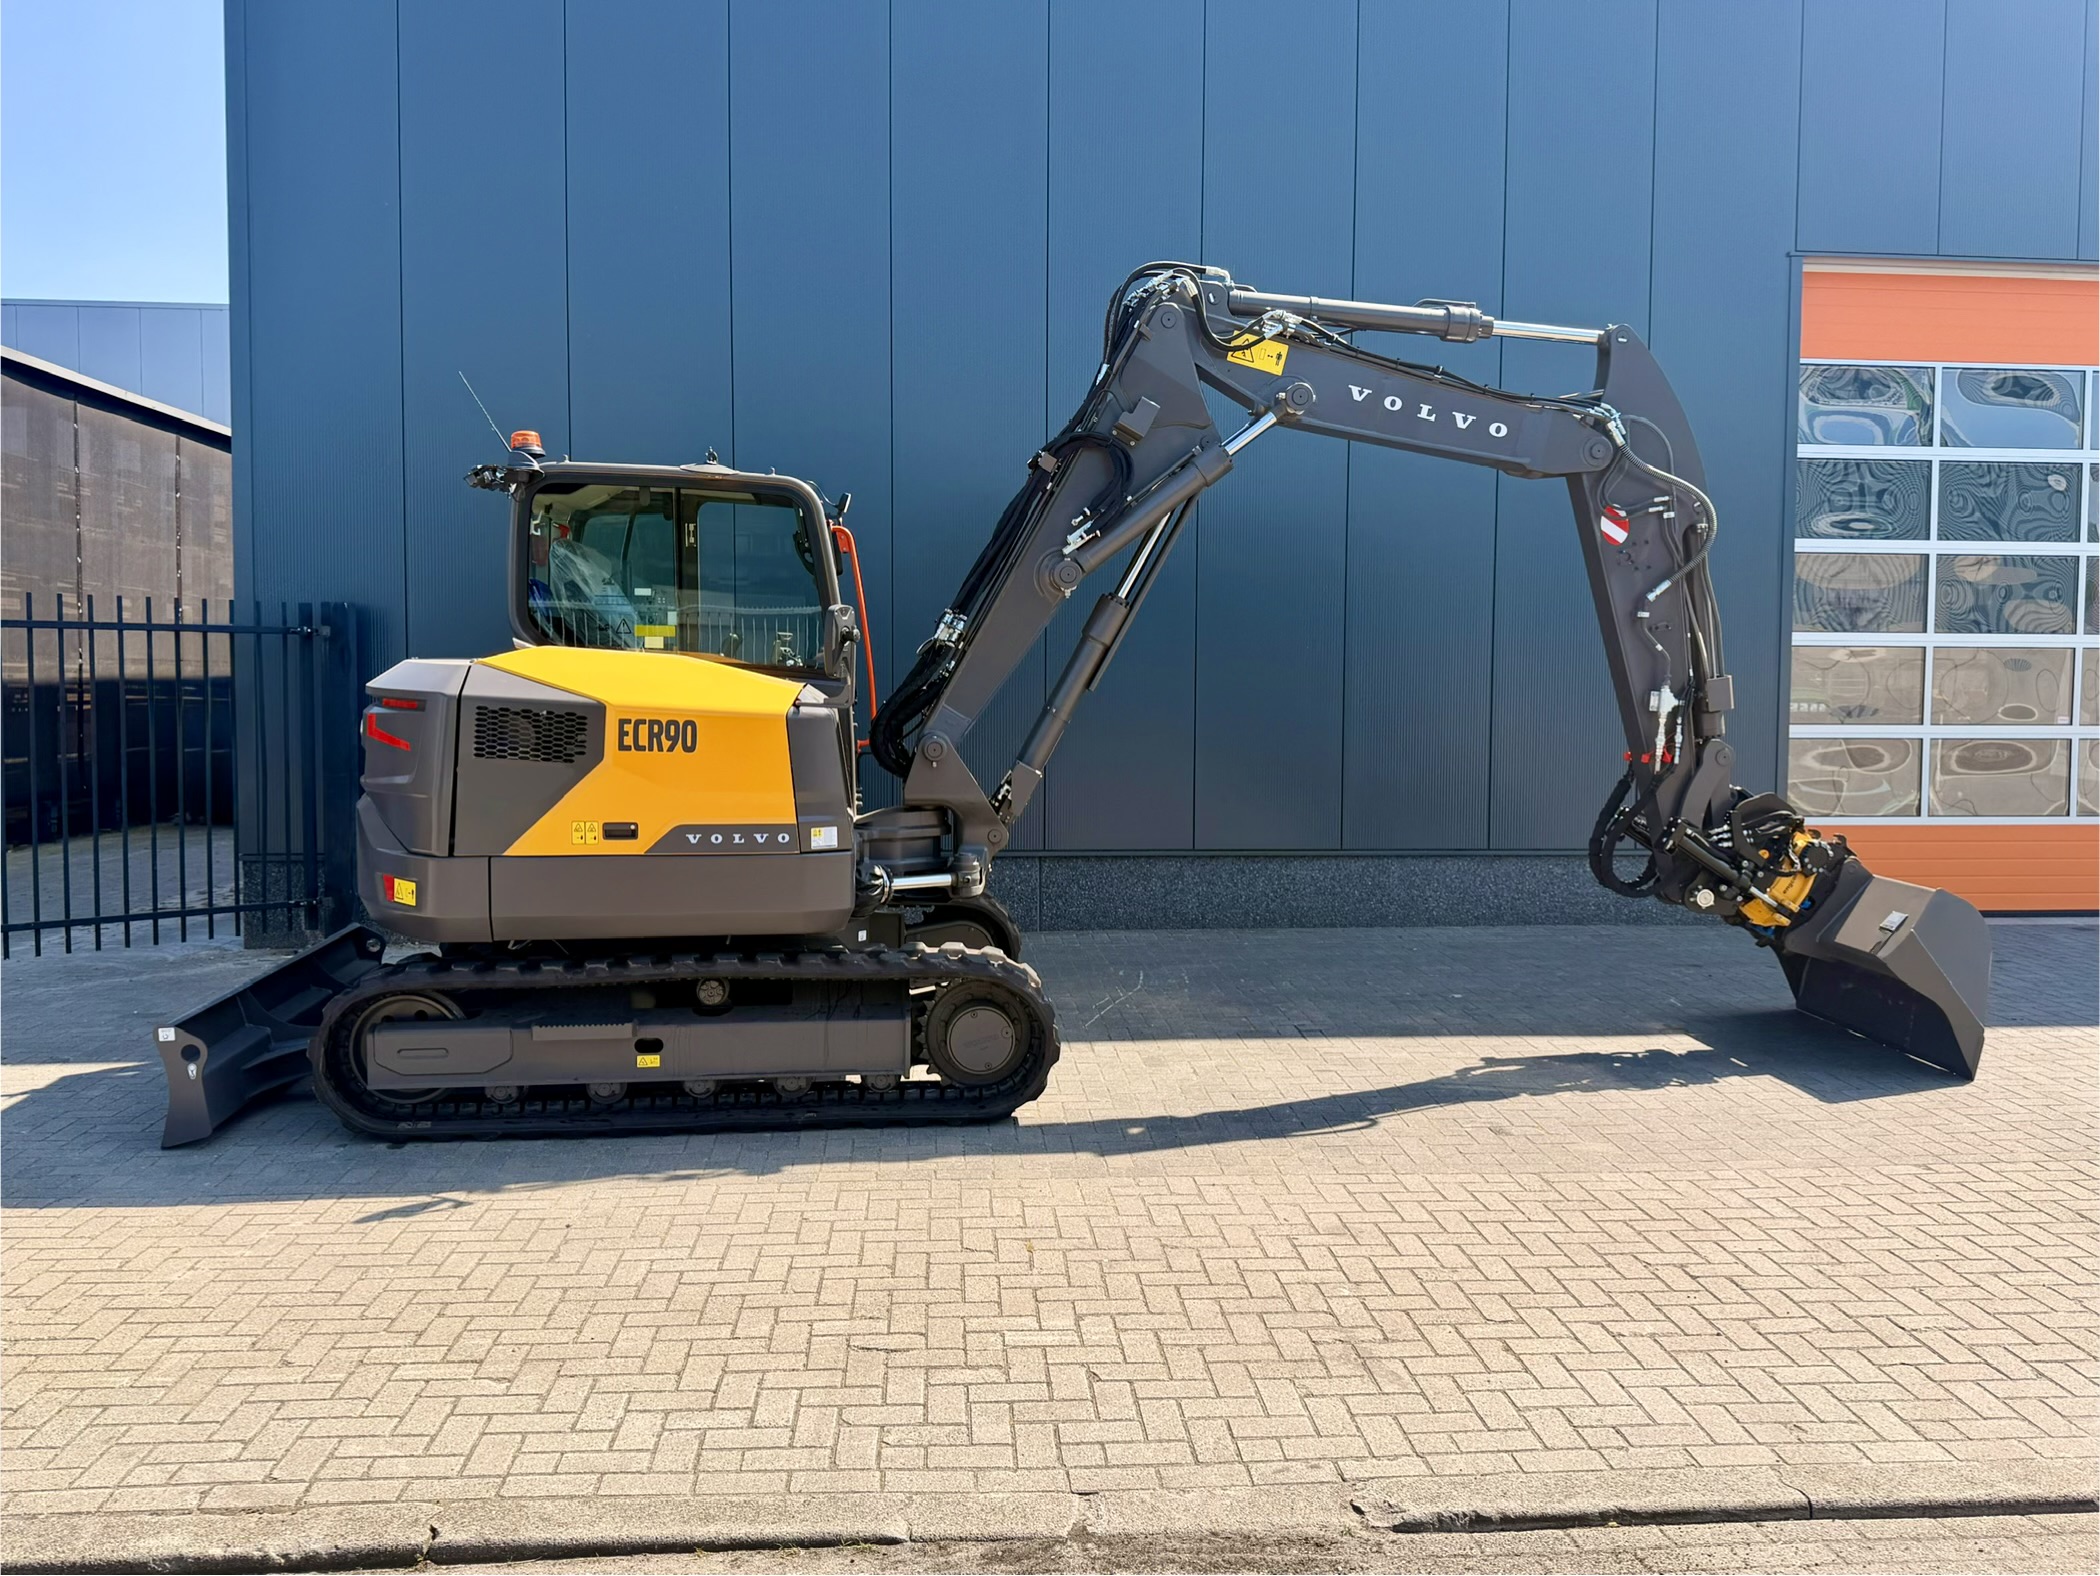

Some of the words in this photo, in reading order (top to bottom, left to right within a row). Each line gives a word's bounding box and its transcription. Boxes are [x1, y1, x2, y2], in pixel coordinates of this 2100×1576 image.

[1348, 384, 1508, 437] VOLVO
[617, 718, 698, 753] ECR90
[685, 833, 790, 844] VOLVO
